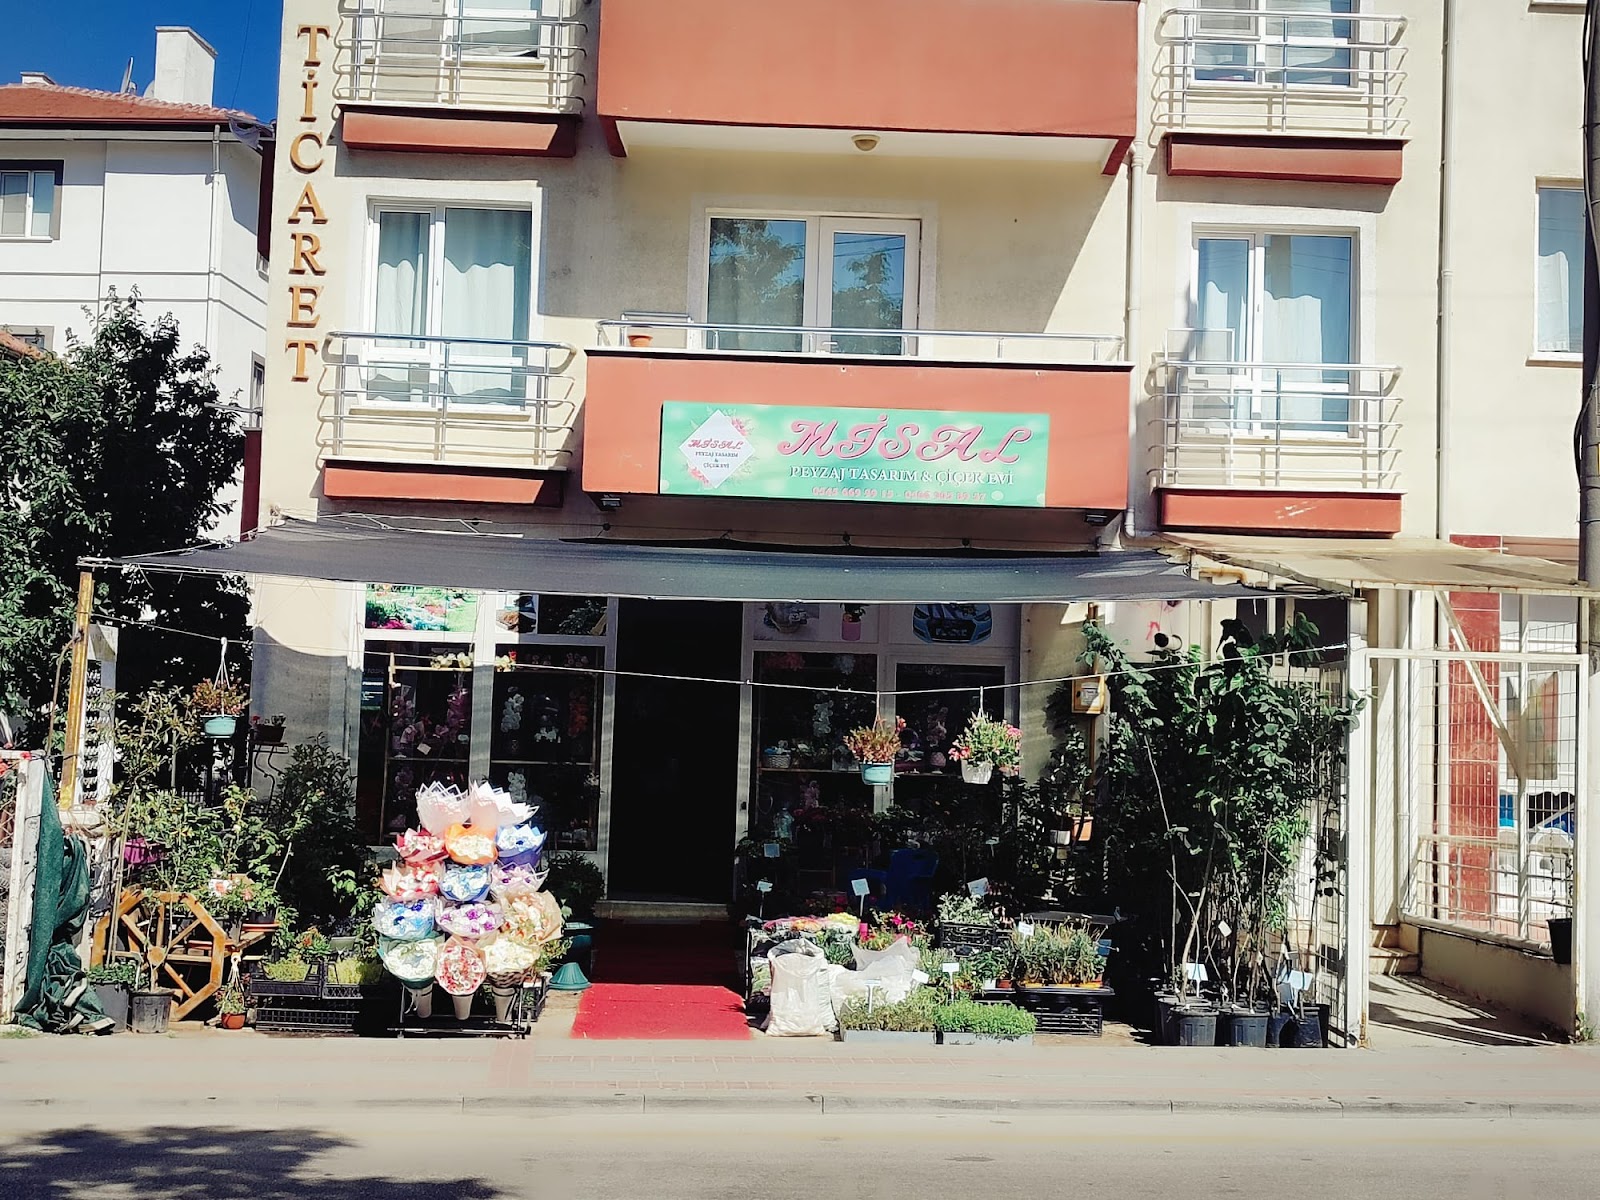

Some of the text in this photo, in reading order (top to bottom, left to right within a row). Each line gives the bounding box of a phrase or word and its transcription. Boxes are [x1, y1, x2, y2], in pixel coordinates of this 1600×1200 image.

[285, 23, 330, 382] TİCARET
[776, 413, 1033, 464] MİSAL
[789, 466, 1015, 487] PEYZAJ TASARIM & ÇİÇEK EVİ
